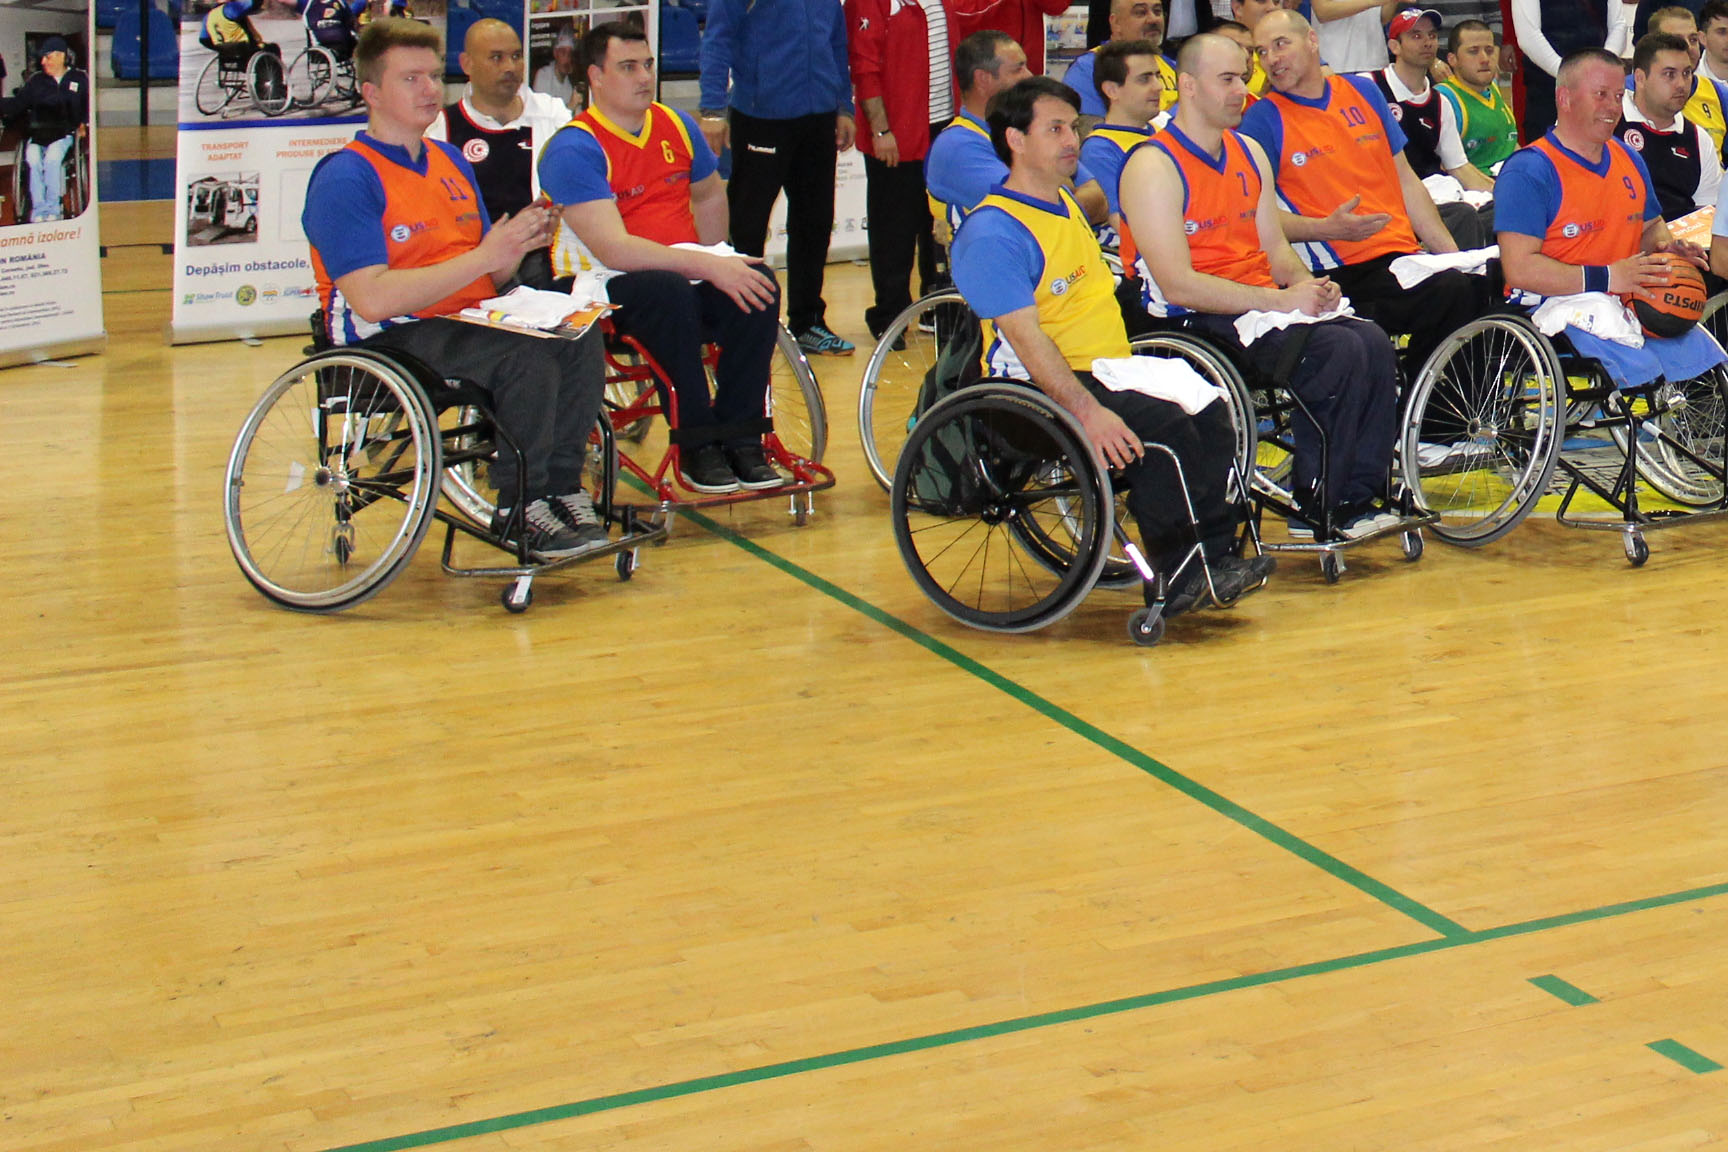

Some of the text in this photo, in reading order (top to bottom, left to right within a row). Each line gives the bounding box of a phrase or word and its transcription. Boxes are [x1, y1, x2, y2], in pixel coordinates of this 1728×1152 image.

[1339, 105, 1366, 128] 10
[1701, 102, 1712, 119] 9
[202, 141, 249, 151] TRANSPORT
[207, 152, 243, 161] ADAPTAT
[276, 149, 314, 158] PRODUSE
[661, 139, 675, 164] 6
[440, 177, 468, 200] 11
[1236, 171, 1249, 197] 7
[1622, 175, 1636, 200] 9
[185, 262, 241, 277] Depășim
